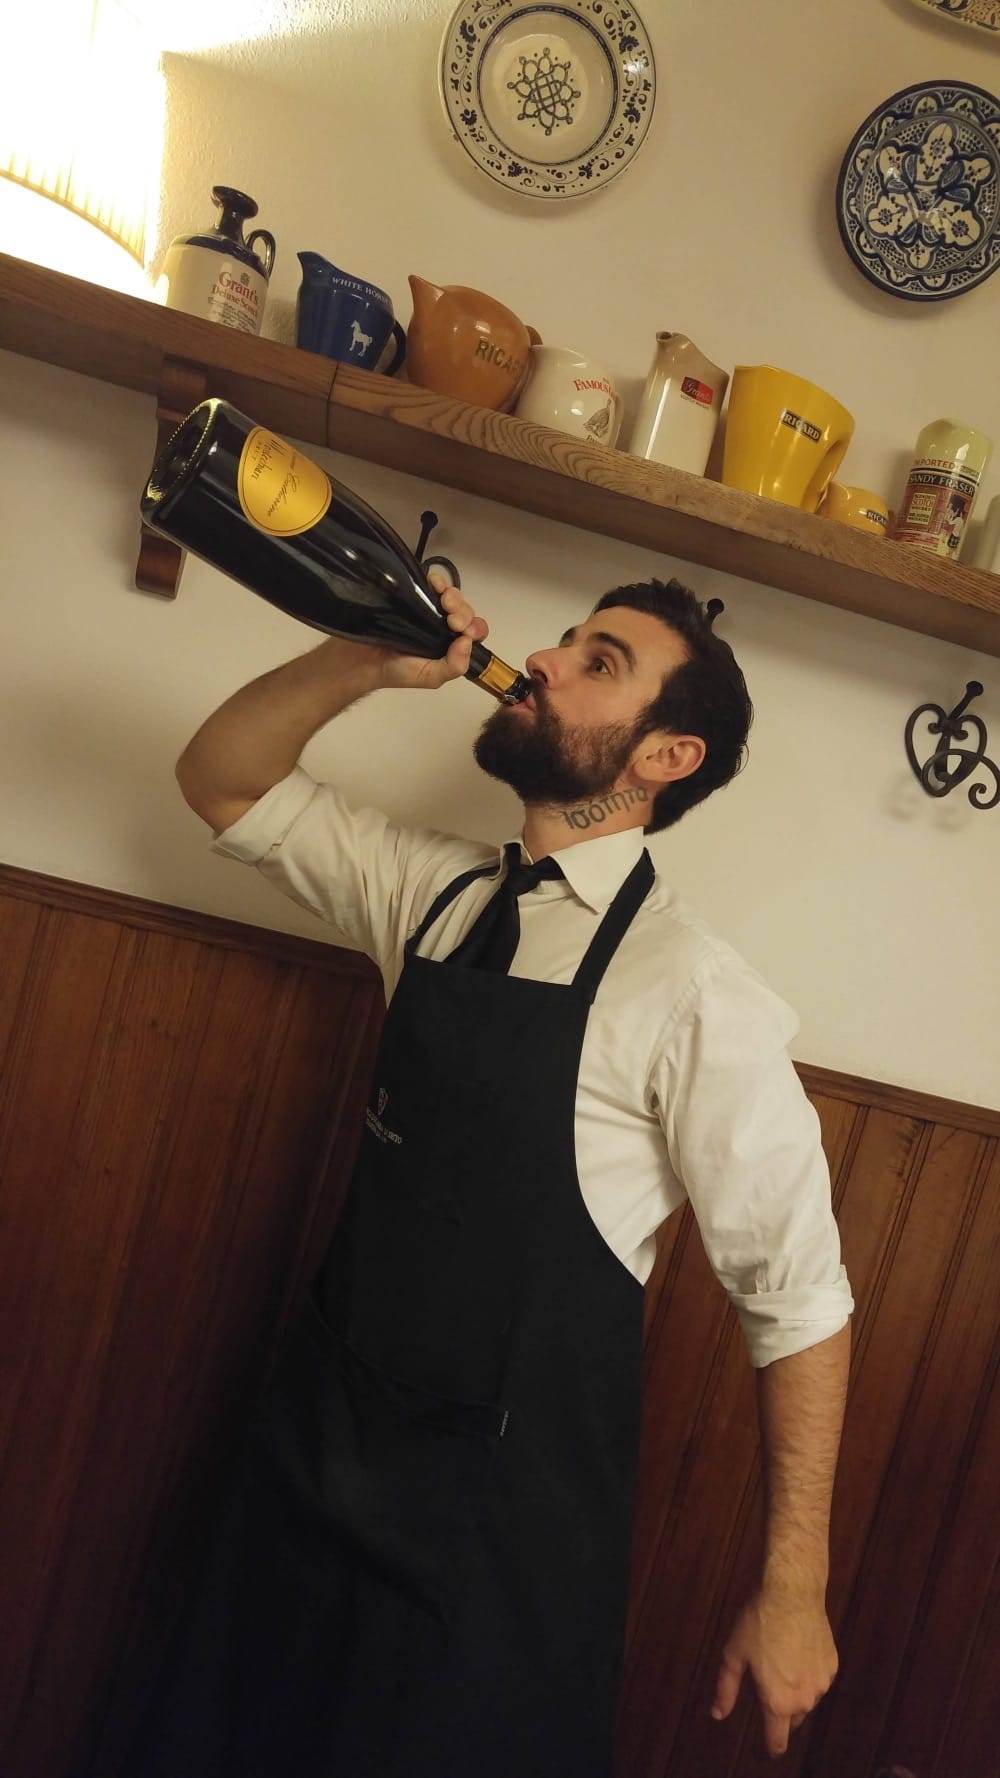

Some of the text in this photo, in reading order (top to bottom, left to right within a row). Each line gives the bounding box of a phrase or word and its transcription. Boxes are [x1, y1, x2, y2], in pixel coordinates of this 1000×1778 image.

[211, 284, 241, 304] Deluxe
[218, 271, 258, 305] Grant's
[332, 277, 363, 291] WHITE
[573, 379, 609, 394] FAMOUS
[783, 413, 820, 440] RICARD
[910, 474, 974, 497] SANDY FRASER
